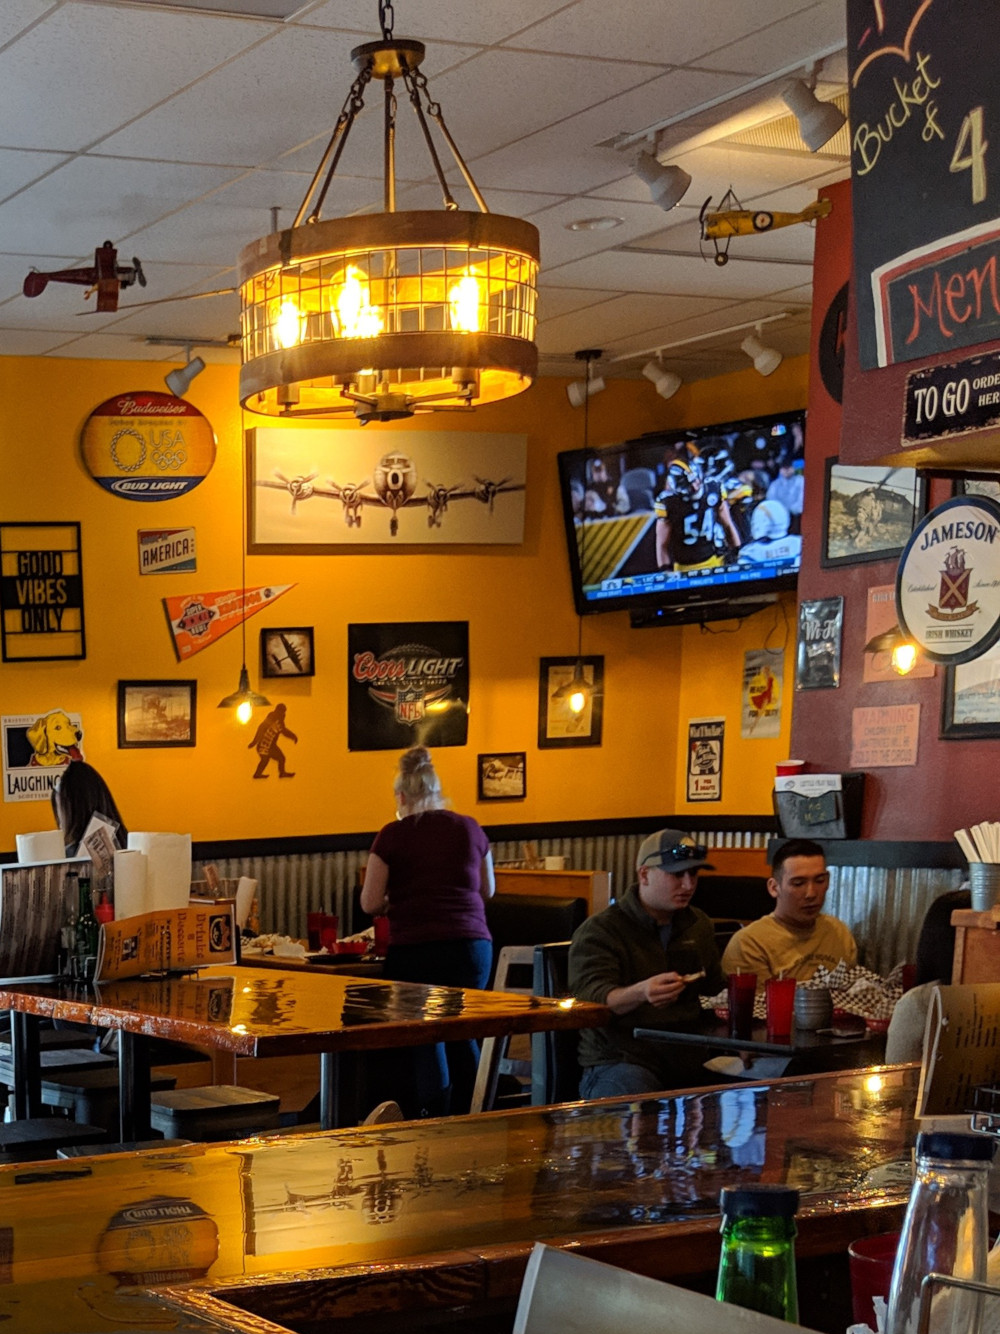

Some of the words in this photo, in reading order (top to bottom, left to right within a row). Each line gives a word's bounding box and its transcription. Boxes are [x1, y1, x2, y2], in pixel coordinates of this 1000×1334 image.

[854, 52, 941, 175] Bucket
[950, 106, 988, 204] 4
[117, 400, 187, 415] Budweiser
[914, 386, 938, 424] TO
[942, 378, 970, 417] GO
[149, 429, 186, 448] USA
[121, 481, 149, 490] BUD
[149, 481, 188, 490] LIGHT
[920, 521, 998, 551] JAMESON
[17, 550, 63, 576] GOOD
[142, 538, 189, 567] AMERICA
[16, 578, 67, 605] VIBES
[907, 583, 937, 593] Established
[20, 607, 64, 633] ONLY
[925, 629, 943, 639] IRISH
[944, 628, 974, 639] WHISKEY
[353, 651, 406, 681] Coors
[406, 657, 464, 677] LIGHT
[399, 701, 421, 720] NFL
[258, 720, 283, 756] BELIEVE
